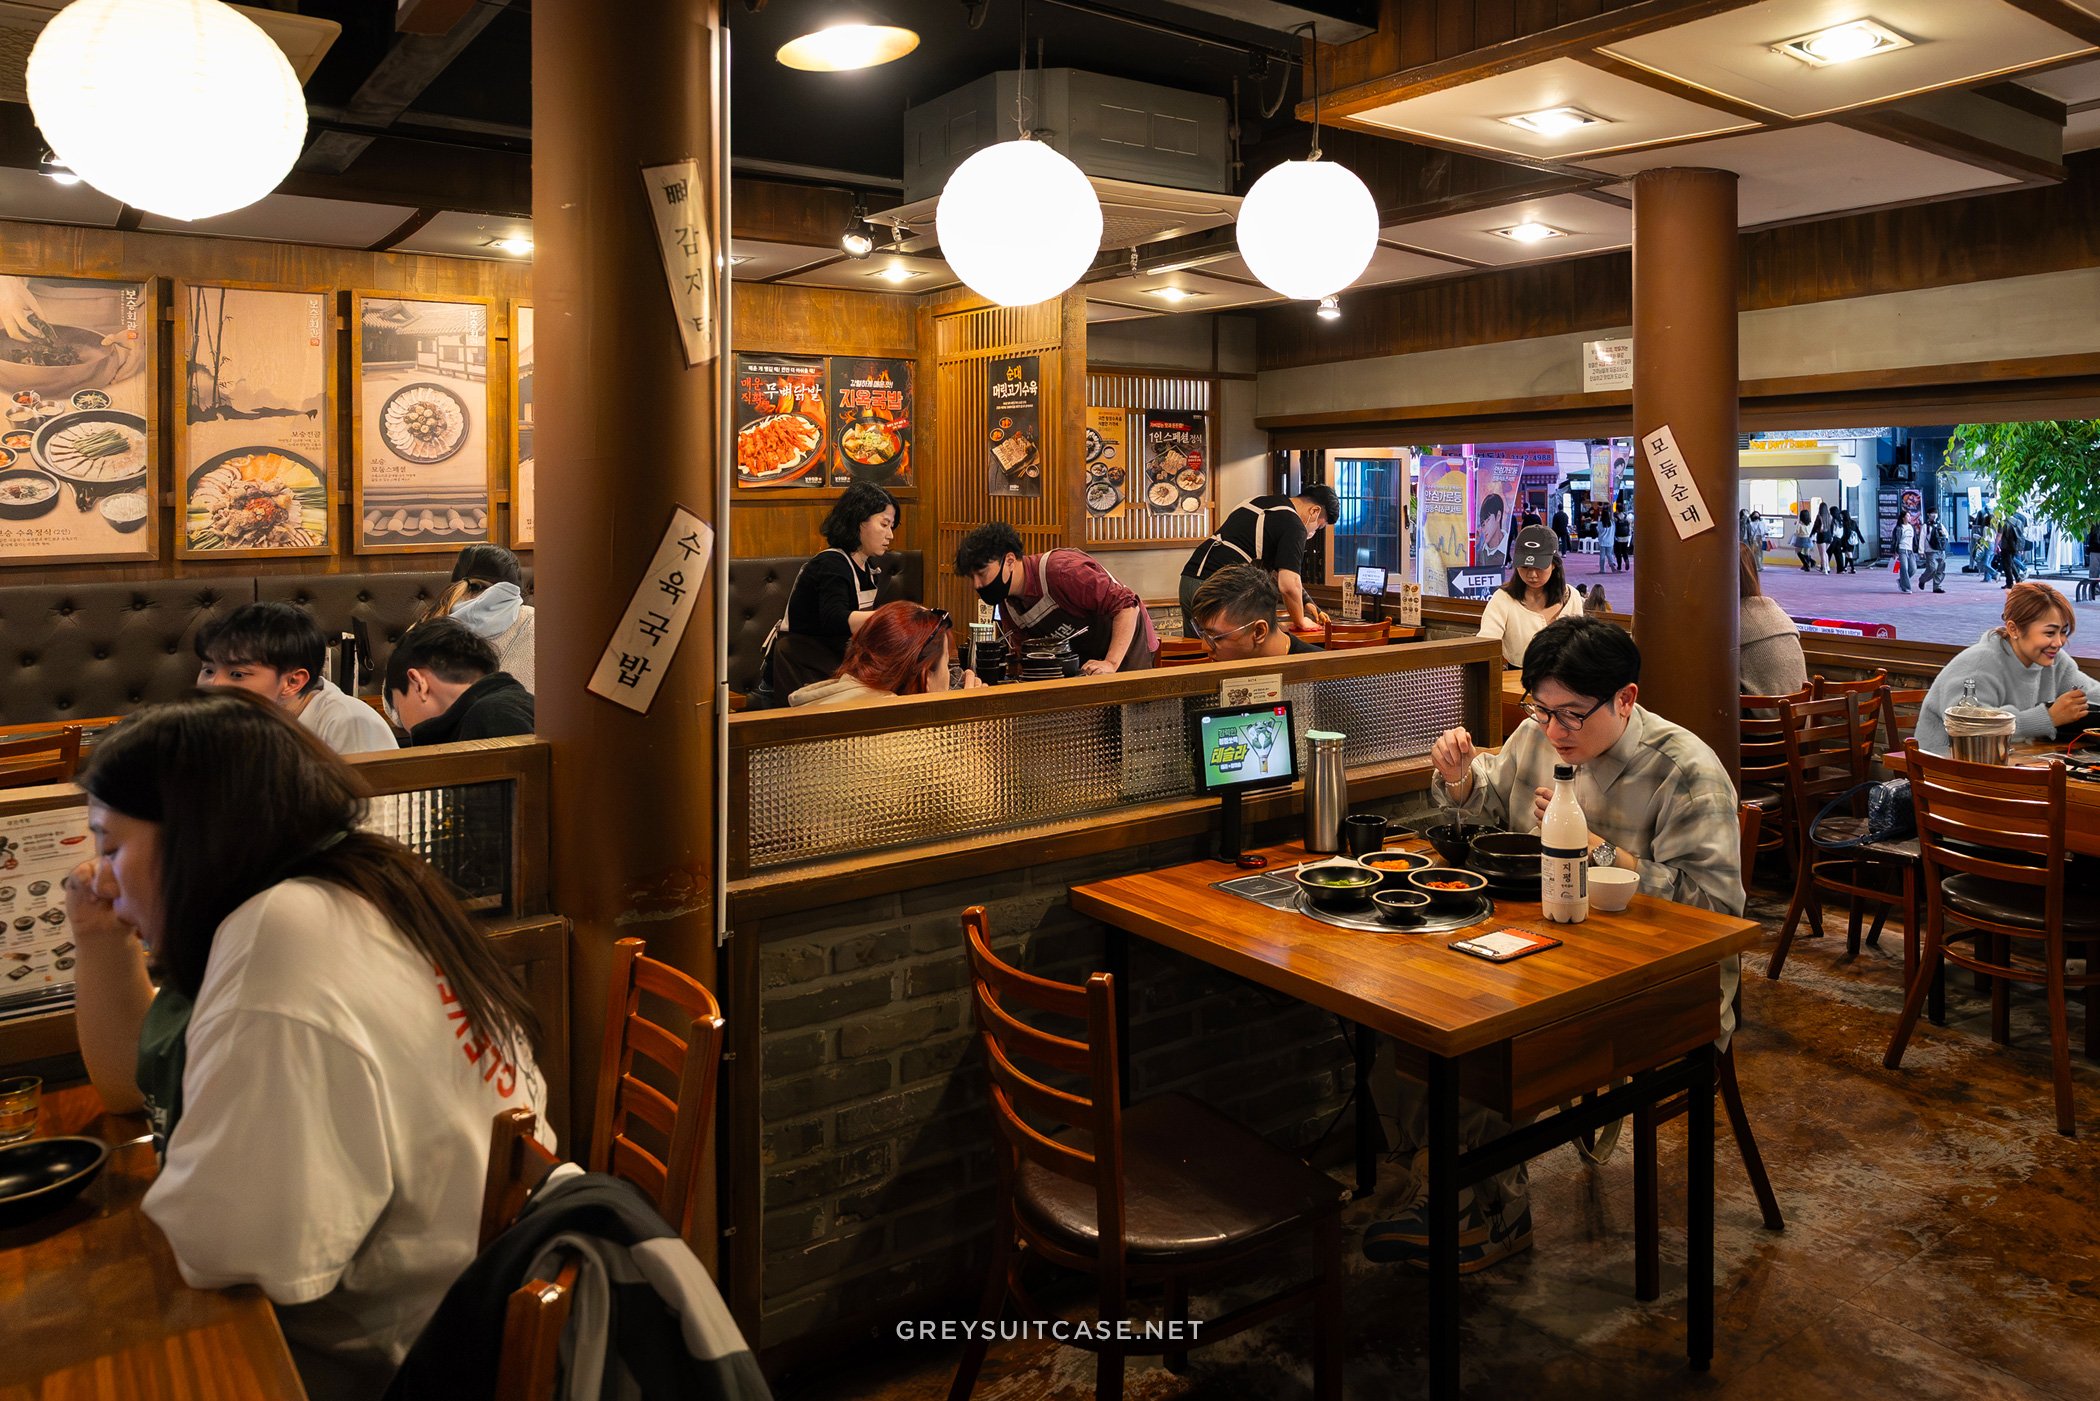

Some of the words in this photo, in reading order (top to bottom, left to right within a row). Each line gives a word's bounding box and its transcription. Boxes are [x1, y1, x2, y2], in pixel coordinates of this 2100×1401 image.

[126, 289, 138, 331] 보승회관
[1006, 364, 1022, 381] 순대
[838, 388, 904, 411] 지옥국밥
[992, 380, 1038, 399] 머릿고기수육
[1149, 431, 1163, 443] 1인
[1163, 431, 1190, 443] 스페셜
[1189, 434, 1202, 443] 정식
[1651, 437, 1701, 523] 모둠순대
[1424, 490, 1463, 503] 안심가로등
[1468, 575, 1495, 587] LEFT
[617, 531, 701, 688] 수육국밥
[1562, 862, 1571, 883] 지평
[434, 962, 517, 1098] CLEVE
